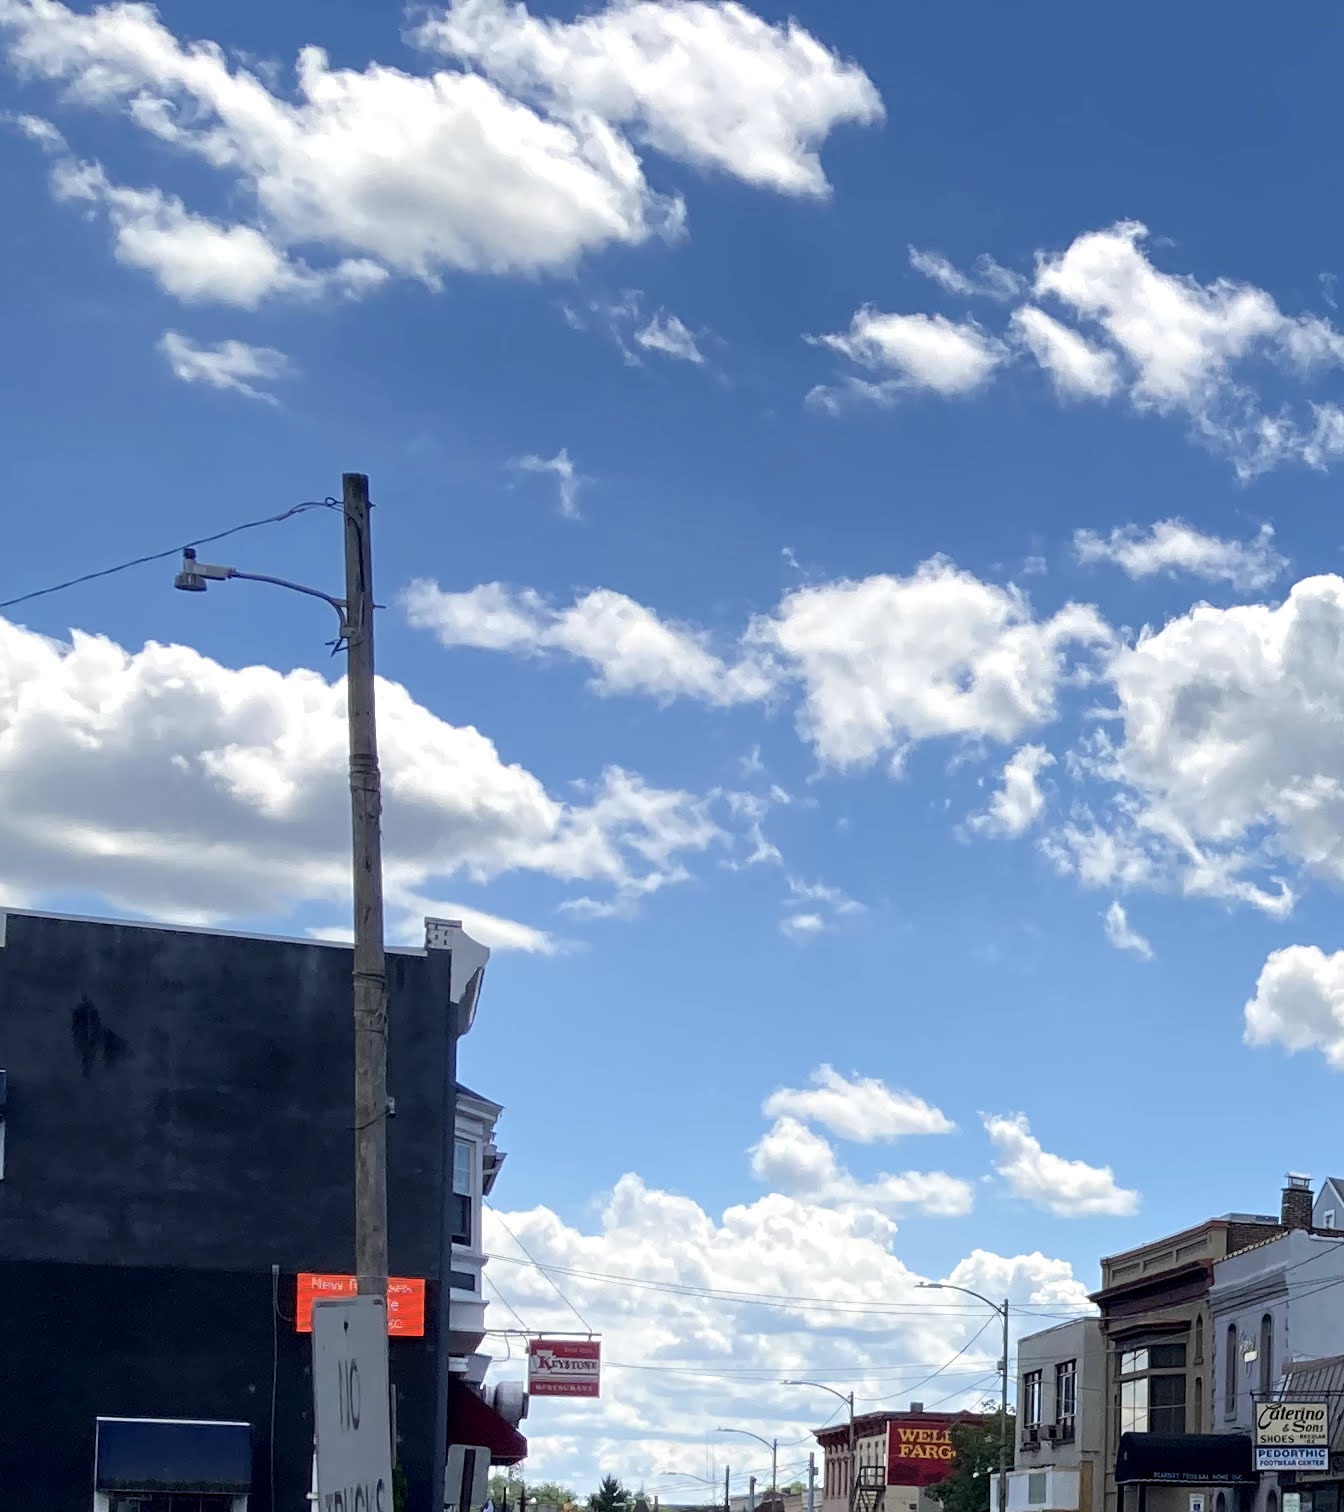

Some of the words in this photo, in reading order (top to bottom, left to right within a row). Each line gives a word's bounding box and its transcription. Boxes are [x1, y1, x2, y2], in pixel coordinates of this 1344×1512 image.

[538, 1356, 597, 1370] KEYSTONE
[1258, 1403, 1324, 1430] Caterino
[1282, 1423, 1290, 1432] &
[1292, 1420, 1324, 1432] Sons
[1260, 1434, 1295, 1443] SHOES
[1258, 1449, 1326, 1458] PEDORTHIC
